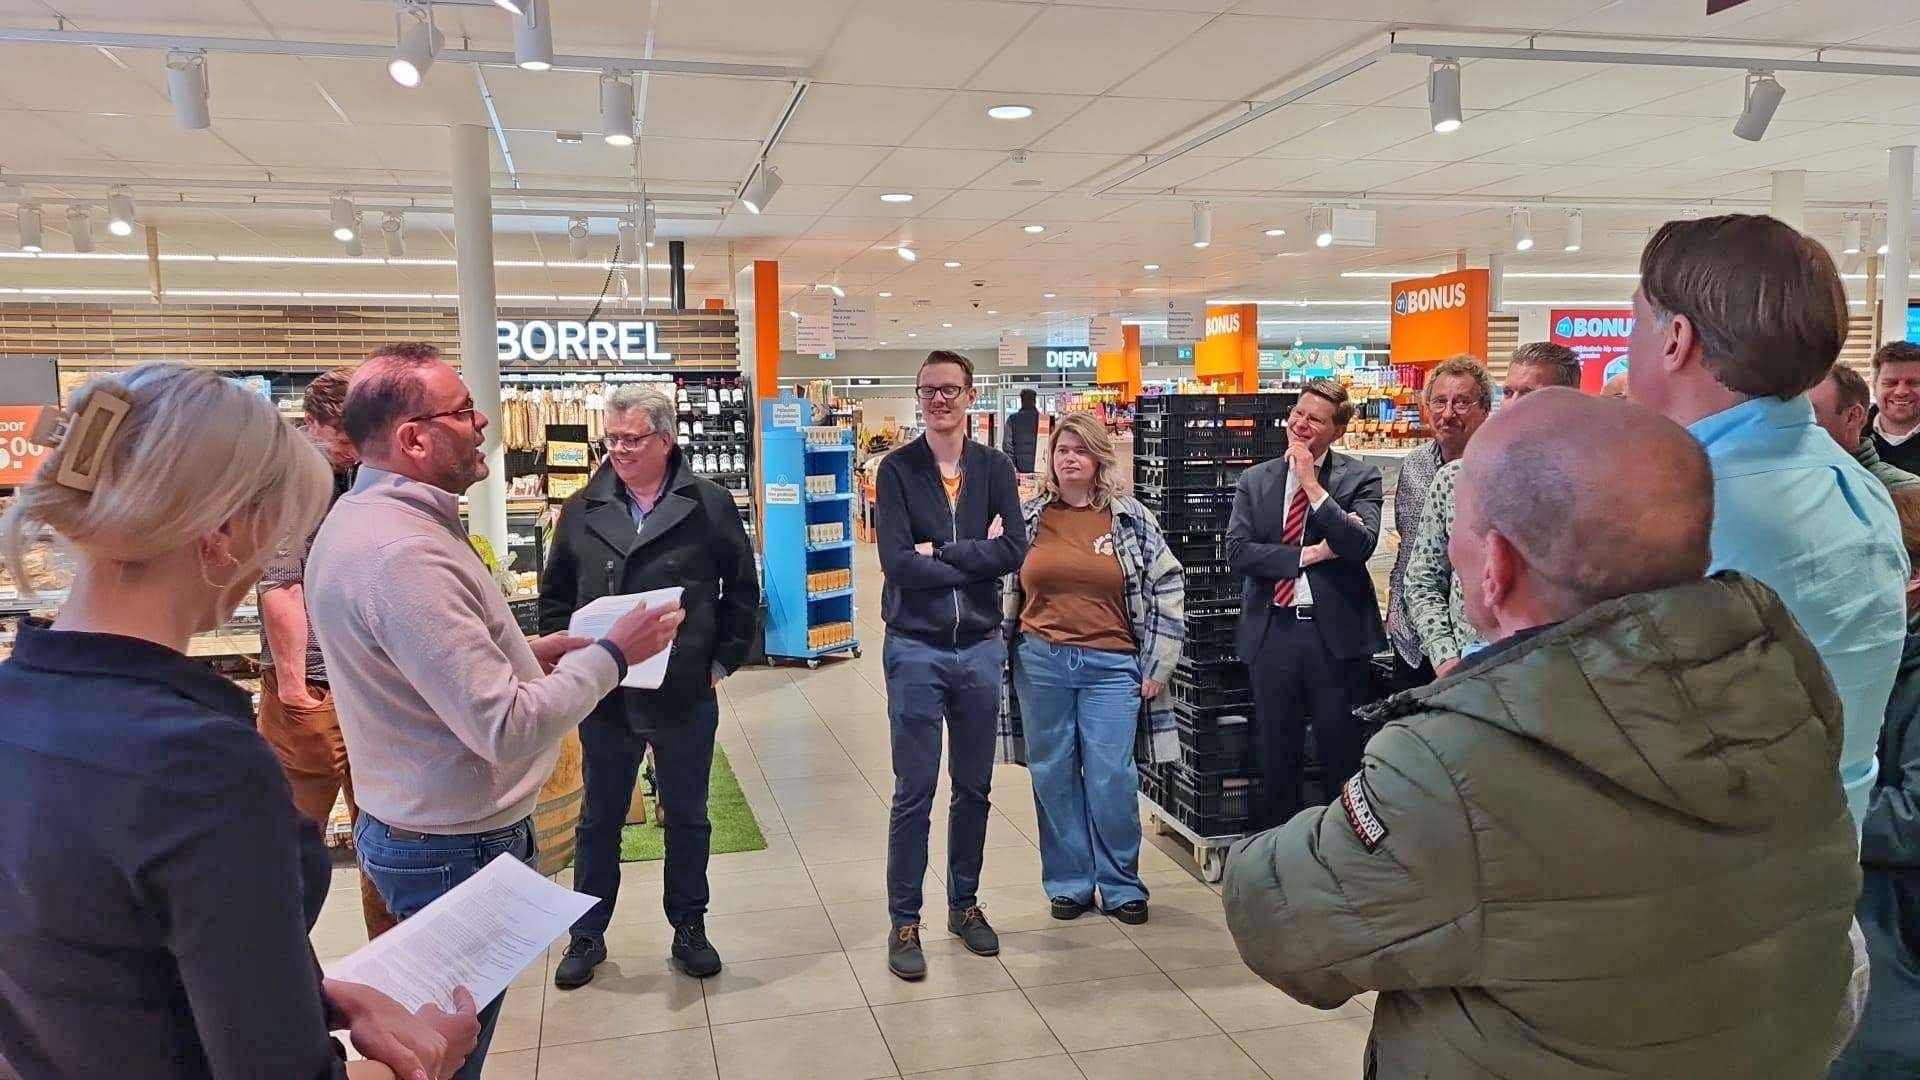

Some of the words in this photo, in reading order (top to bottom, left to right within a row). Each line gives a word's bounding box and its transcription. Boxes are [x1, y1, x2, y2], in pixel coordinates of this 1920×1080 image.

[1168, 301, 1174, 309] 6
[1407, 282, 1466, 314] BONUS
[1206, 312, 1240, 336] BONUS
[1573, 317, 1632, 337] BONU
[497, 320, 671, 360] BORREL
[0, 421, 26, 432] oor
